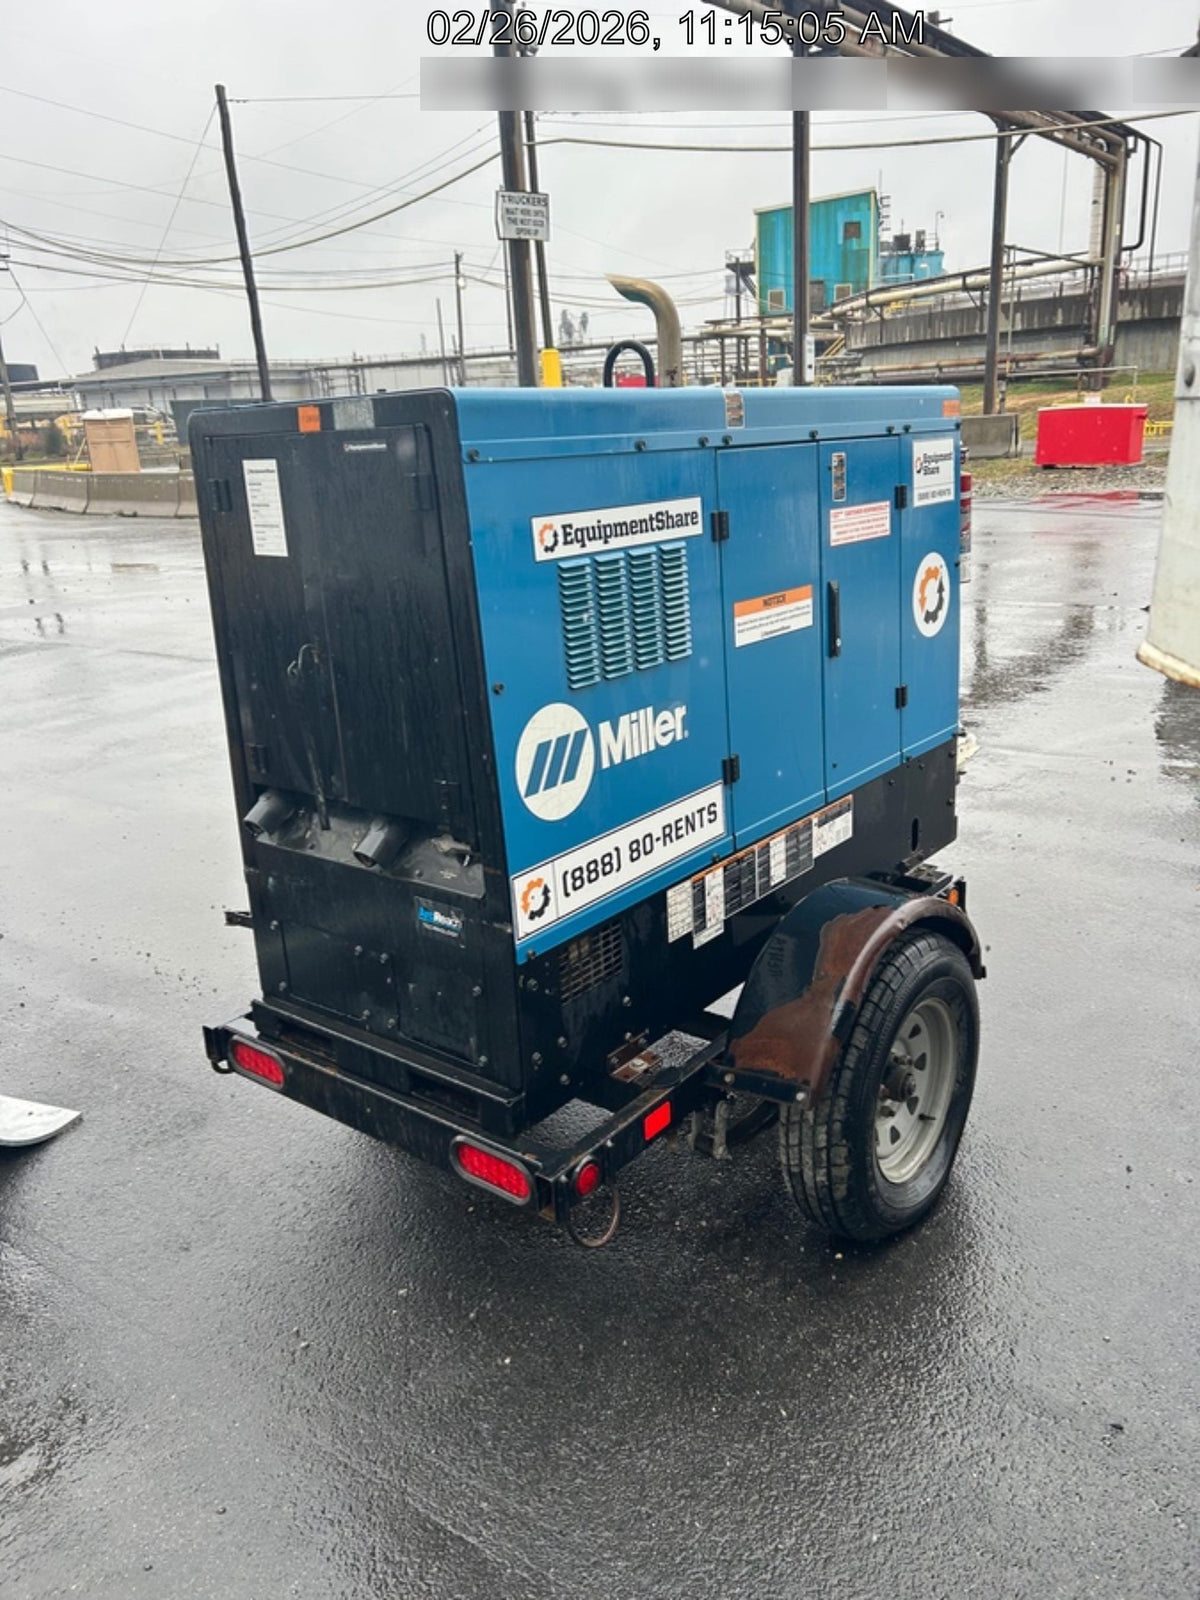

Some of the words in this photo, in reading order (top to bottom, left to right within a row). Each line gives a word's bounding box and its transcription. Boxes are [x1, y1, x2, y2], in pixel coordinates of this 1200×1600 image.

[501, 194, 549, 207] TRUCKERS
[561, 510, 699, 548] EquipmentShare
[599, 705, 687, 769] Miller
[562, 846, 621, 897] (888)
[629, 802, 718, 863] 80-RENTS
